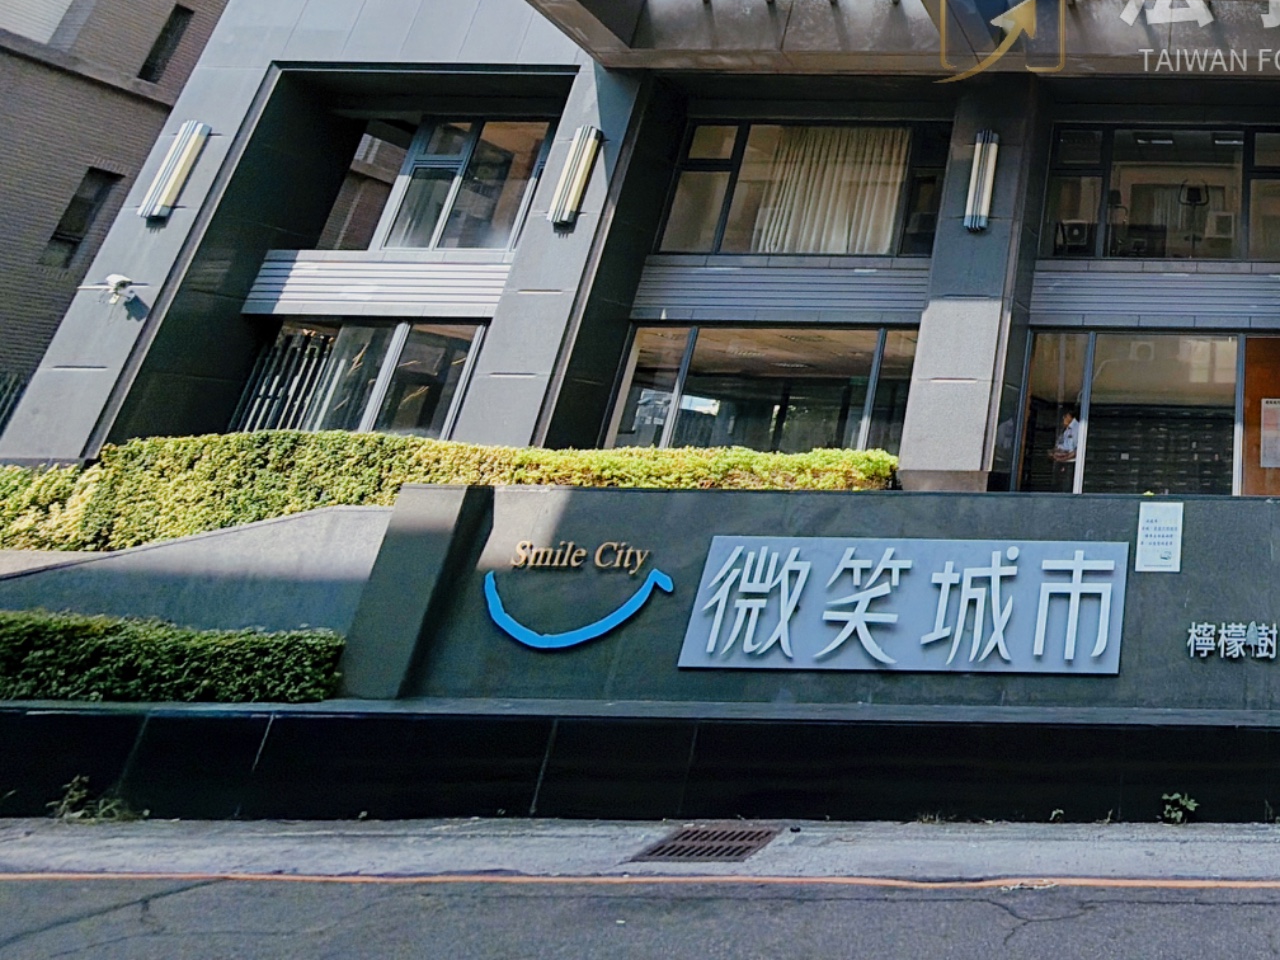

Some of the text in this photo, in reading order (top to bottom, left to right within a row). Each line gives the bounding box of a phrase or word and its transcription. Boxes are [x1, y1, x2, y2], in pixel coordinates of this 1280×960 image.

[510, 540, 650, 575] Smile City
[701, 545, 1116, 666] 微笑城市
